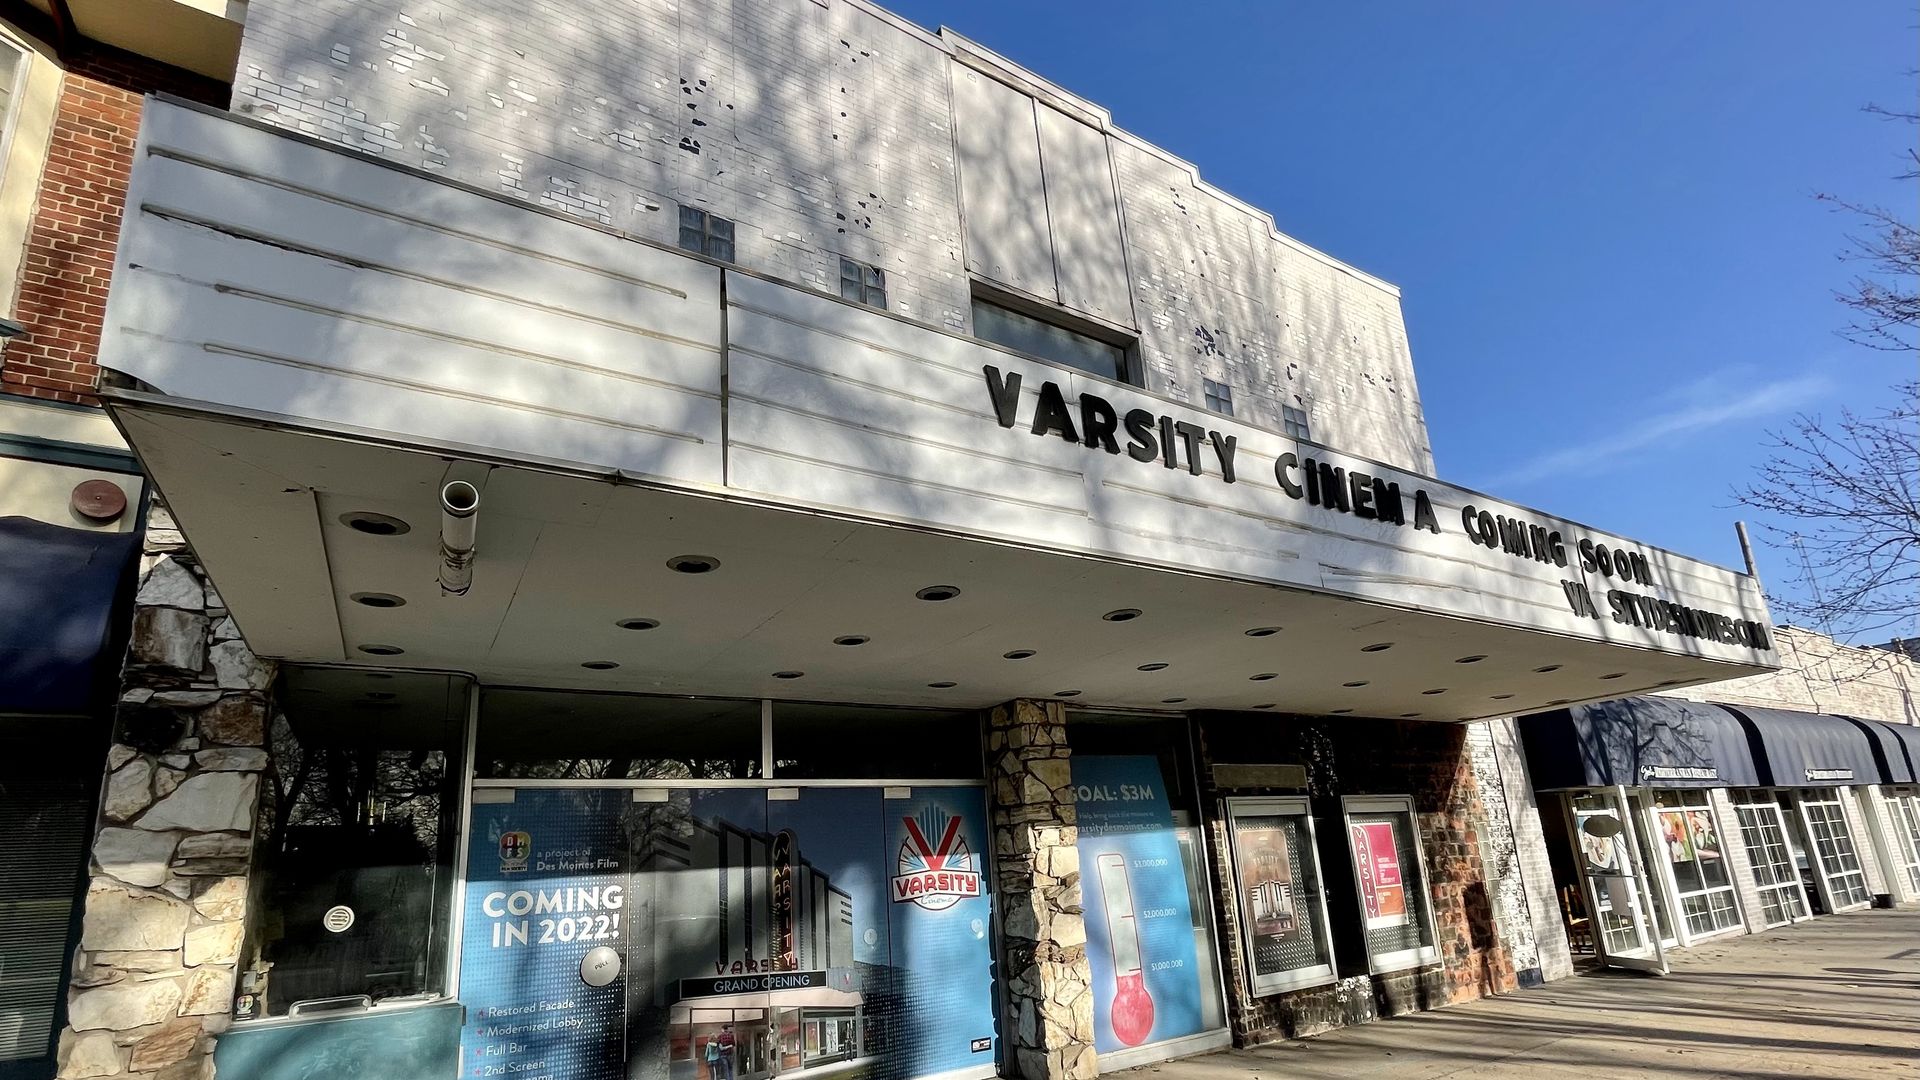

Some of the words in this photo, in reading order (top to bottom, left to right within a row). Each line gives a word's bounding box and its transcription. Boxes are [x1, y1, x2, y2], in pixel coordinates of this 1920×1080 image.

[982, 364, 1238, 484] VARSITY
[1461, 504, 1568, 569] COMING
[1579, 537, 1653, 587] SOON
[1561, 579, 1600, 621] VA
[1120, 784, 1155, 802] $3M
[545, 848, 579, 861] project
[582, 846, 592, 856] of
[536, 861, 556, 871] Des
[559, 860, 594, 871] Moines
[597, 858, 619, 869] Film
[1355, 829, 1376, 919] VARSITY
[895, 873, 977, 897] VARSITY
[482, 884, 624, 918] COMING
[1143, 907, 1177, 918] $2,000,000
[492, 920, 529, 948] IN
[537, 913, 621, 944] 2022!
[713, 978, 759, 993] GRAND
[761, 974, 811, 989] OPENING
[488, 1002, 536, 1018] Restored
[539, 999, 575, 1012] Facade
[486, 1020, 551, 1037] Modernized
[552, 1017, 584, 1031] Lobby
[486, 1045, 506, 1057] Full
[509, 1042, 528, 1054] Bar
[484, 1063, 506, 1077] 2nd
[508, 1061, 546, 1073] Screen
